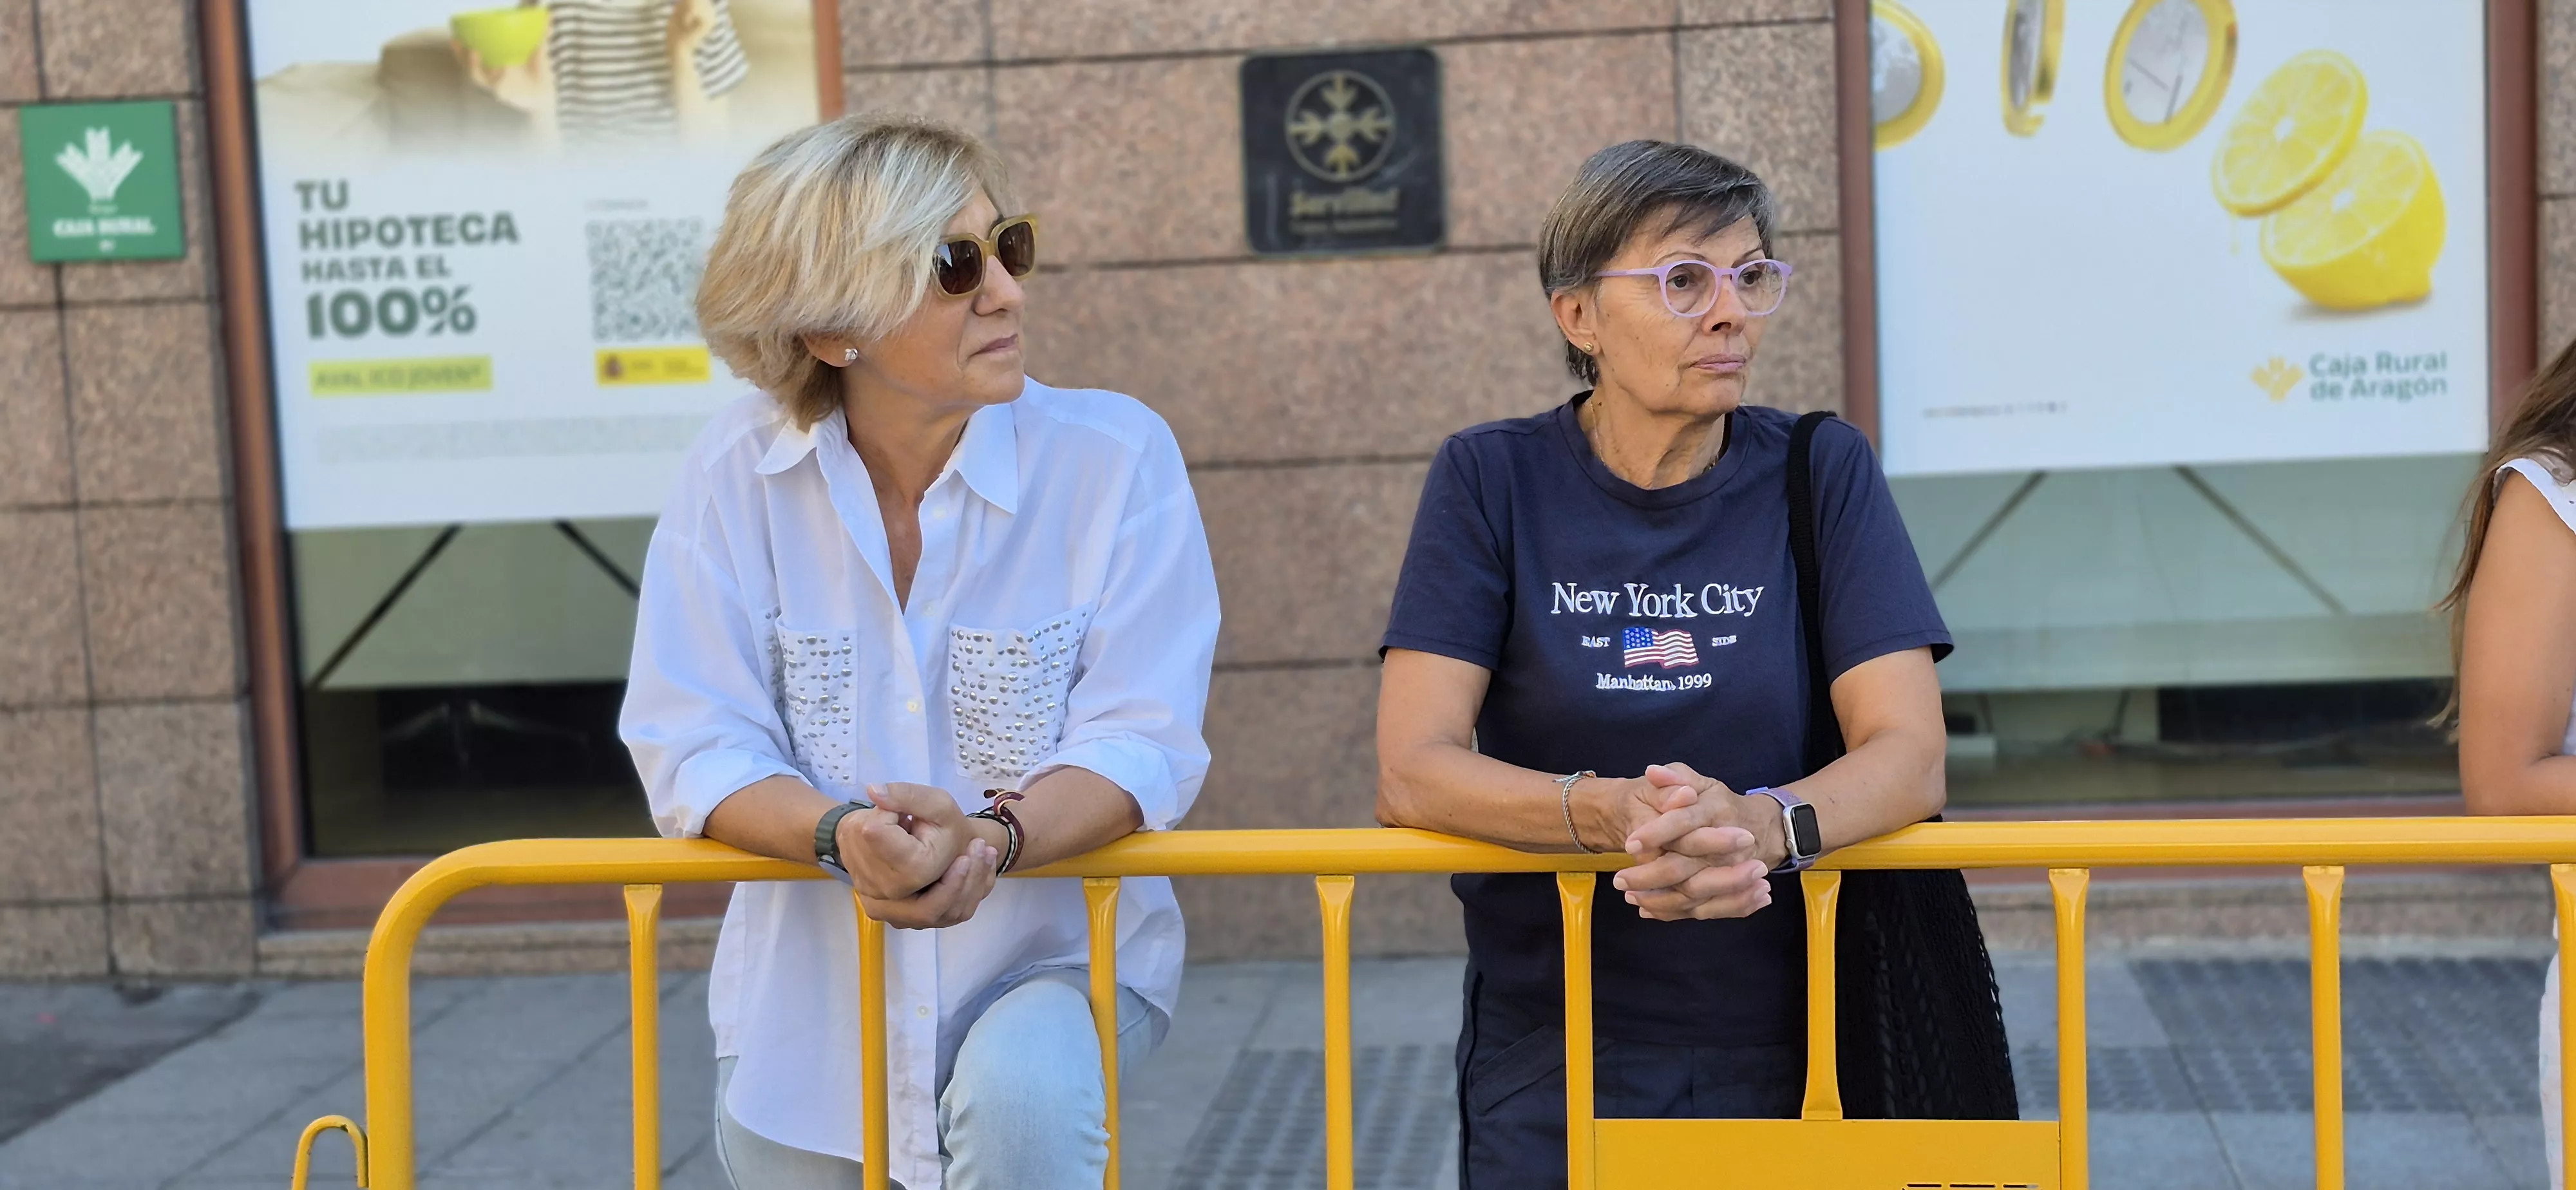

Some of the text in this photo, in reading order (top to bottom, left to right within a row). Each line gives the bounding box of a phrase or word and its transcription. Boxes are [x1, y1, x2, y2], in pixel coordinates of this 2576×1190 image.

[294, 180, 348, 211] TU
[299, 211, 520, 250] HIPOTECA
[301, 254, 451, 283] HASTA EL
[307, 285, 478, 340] 100%
[2309, 350, 2447, 380] Caja Rural
[2309, 376, 2448, 402] de Aragón
[1551, 582, 1765, 618] New York City
[1581, 636, 1611, 648] EAST
[1678, 673, 1712, 690] 1999
